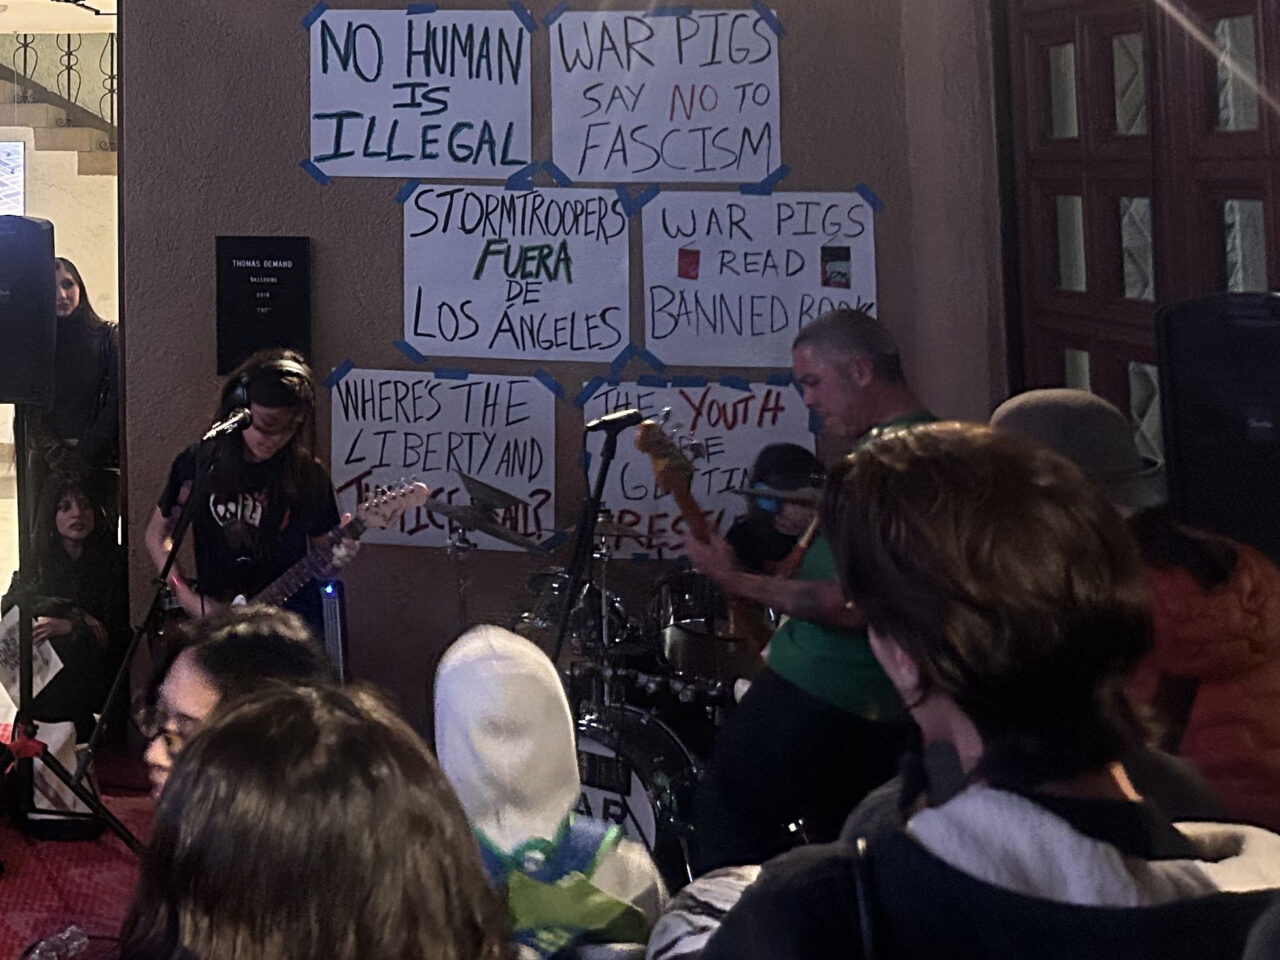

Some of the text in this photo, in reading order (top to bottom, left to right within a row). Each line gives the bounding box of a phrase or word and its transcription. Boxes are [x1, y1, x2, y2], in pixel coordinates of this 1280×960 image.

[320, 19, 524, 85] NO HUMAN
[558, 13, 772, 72] WAR PIGS
[392, 82, 451, 116] IS
[580, 82, 770, 122] SAY NO TO
[312, 110, 528, 166] ILLEGAL
[578, 122, 771, 175] FASCISM
[410, 188, 626, 245] STORMTROOPERS
[661, 201, 865, 241] WAR PIGS
[232, 259, 293, 269] THOMAS DEMAND
[472, 238, 573, 284] FUERA
[719, 248, 806, 278] READ
[413, 286, 479, 342] LOS
[505, 280, 542, 305] DE
[649, 285, 789, 340] BANNED
[336, 379, 531, 428] WHERE'S THE
[593, 386, 786, 430] THE YOUTH
[344, 428, 543, 483] LIBERTY AND
[572, 791, 628, 825] AR
